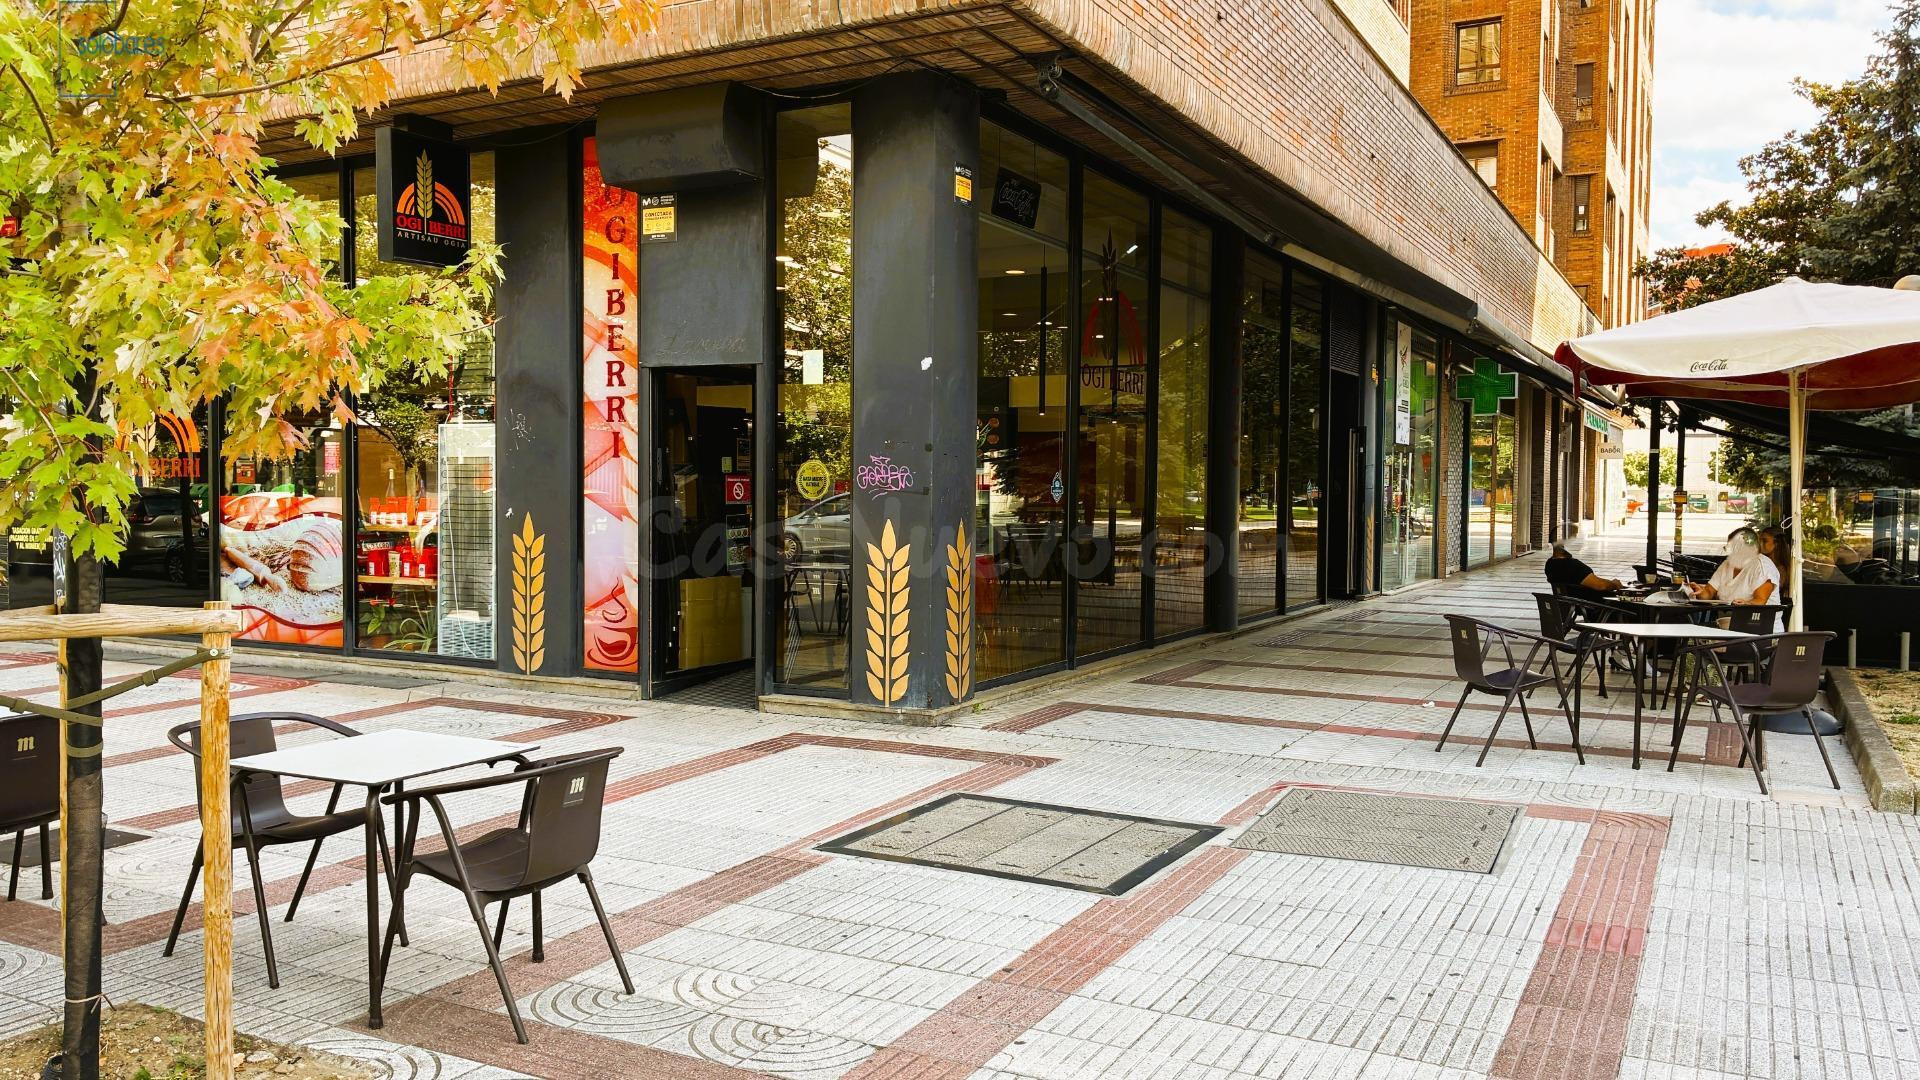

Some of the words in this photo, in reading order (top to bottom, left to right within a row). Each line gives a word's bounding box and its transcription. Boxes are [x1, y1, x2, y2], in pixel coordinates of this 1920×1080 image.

[396, 214, 422, 231] OGI
[429, 220, 466, 239] BERRI
[397, 230, 439, 244] ARTISAU
[443, 239, 466, 248] OGIA
[1690, 358, 1729, 373] Coca-Cola
[1082, 363, 1105, 389] OGI
[147, 456, 201, 478] BERRI
[17, 736, 35, 752] m
[569, 776, 585, 794] m
